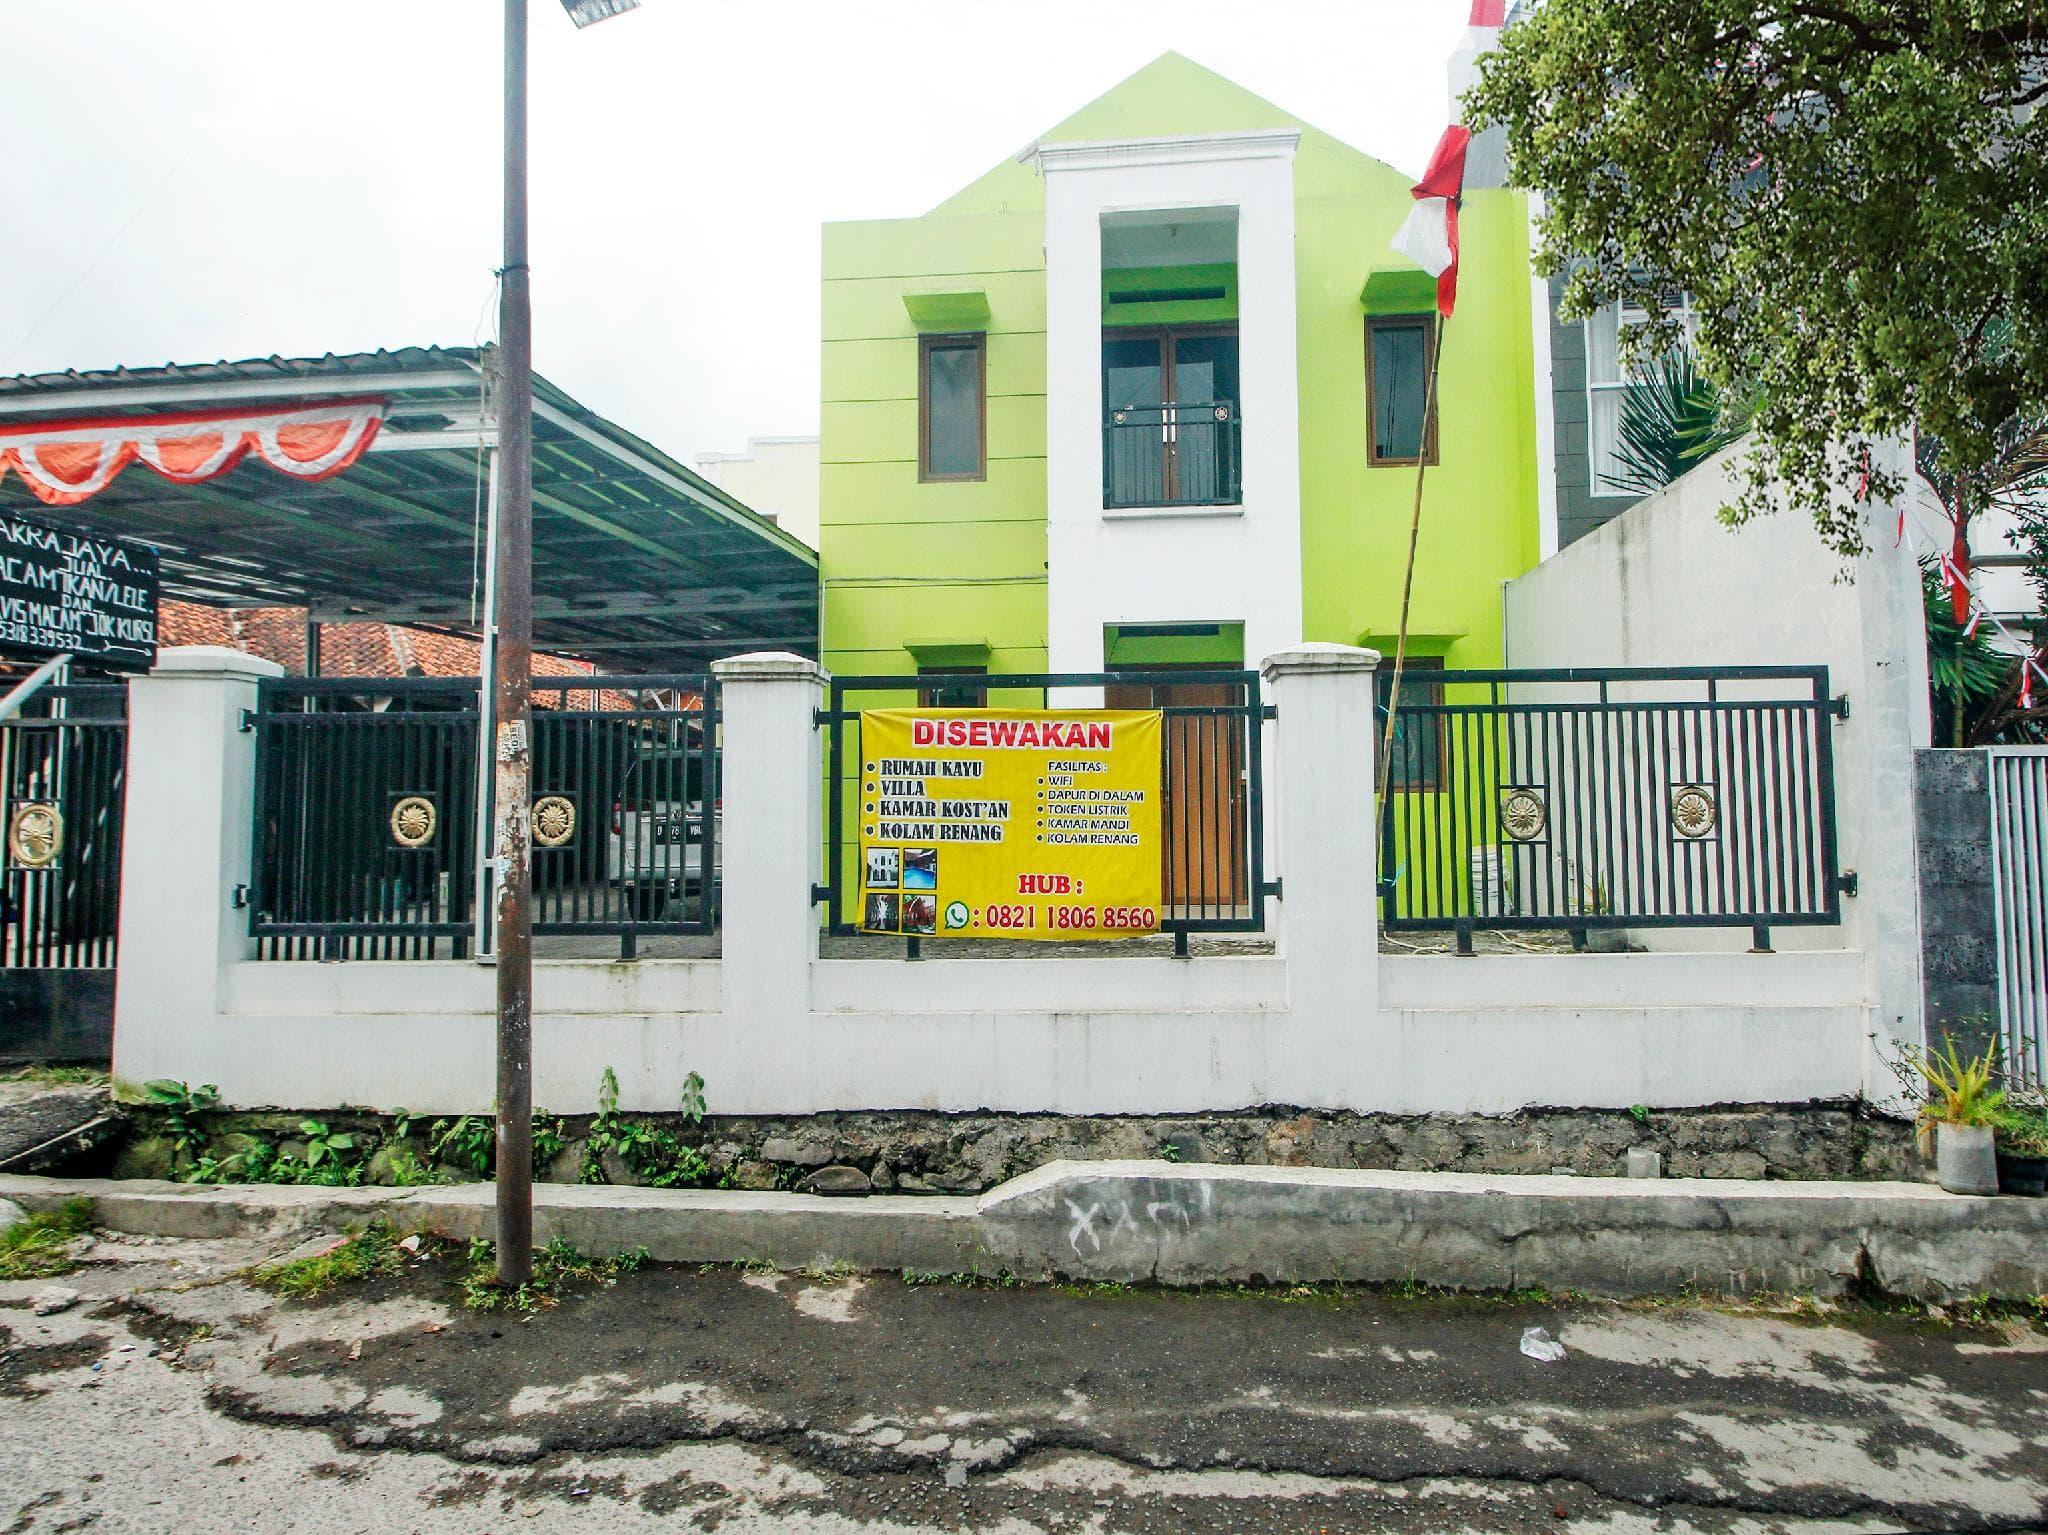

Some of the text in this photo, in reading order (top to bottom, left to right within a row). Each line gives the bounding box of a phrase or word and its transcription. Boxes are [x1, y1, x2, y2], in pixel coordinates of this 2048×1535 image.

[914, 720, 1111, 749] DISEWAKAN
[880, 760, 982, 777] RUMAH KAYU
[881, 780, 925, 796] VILLA
[1048, 776, 1072, 786] WIFI
[1048, 790, 1144, 801] DAPUR DI DALAM
[880, 801, 936, 817] KAMAR
[1048, 805, 1128, 815] TOKEN LISTRIK
[880, 823, 1002, 841] KOLAM RENANG
[1048, 819, 1129, 829] KAMAR MANDI
[1047, 833, 1138, 844] KOLAM RENANG
[986, 904, 1035, 928] 0821
[1047, 906, 1096, 929] 1806
[1103, 907, 1155, 929] 8560
